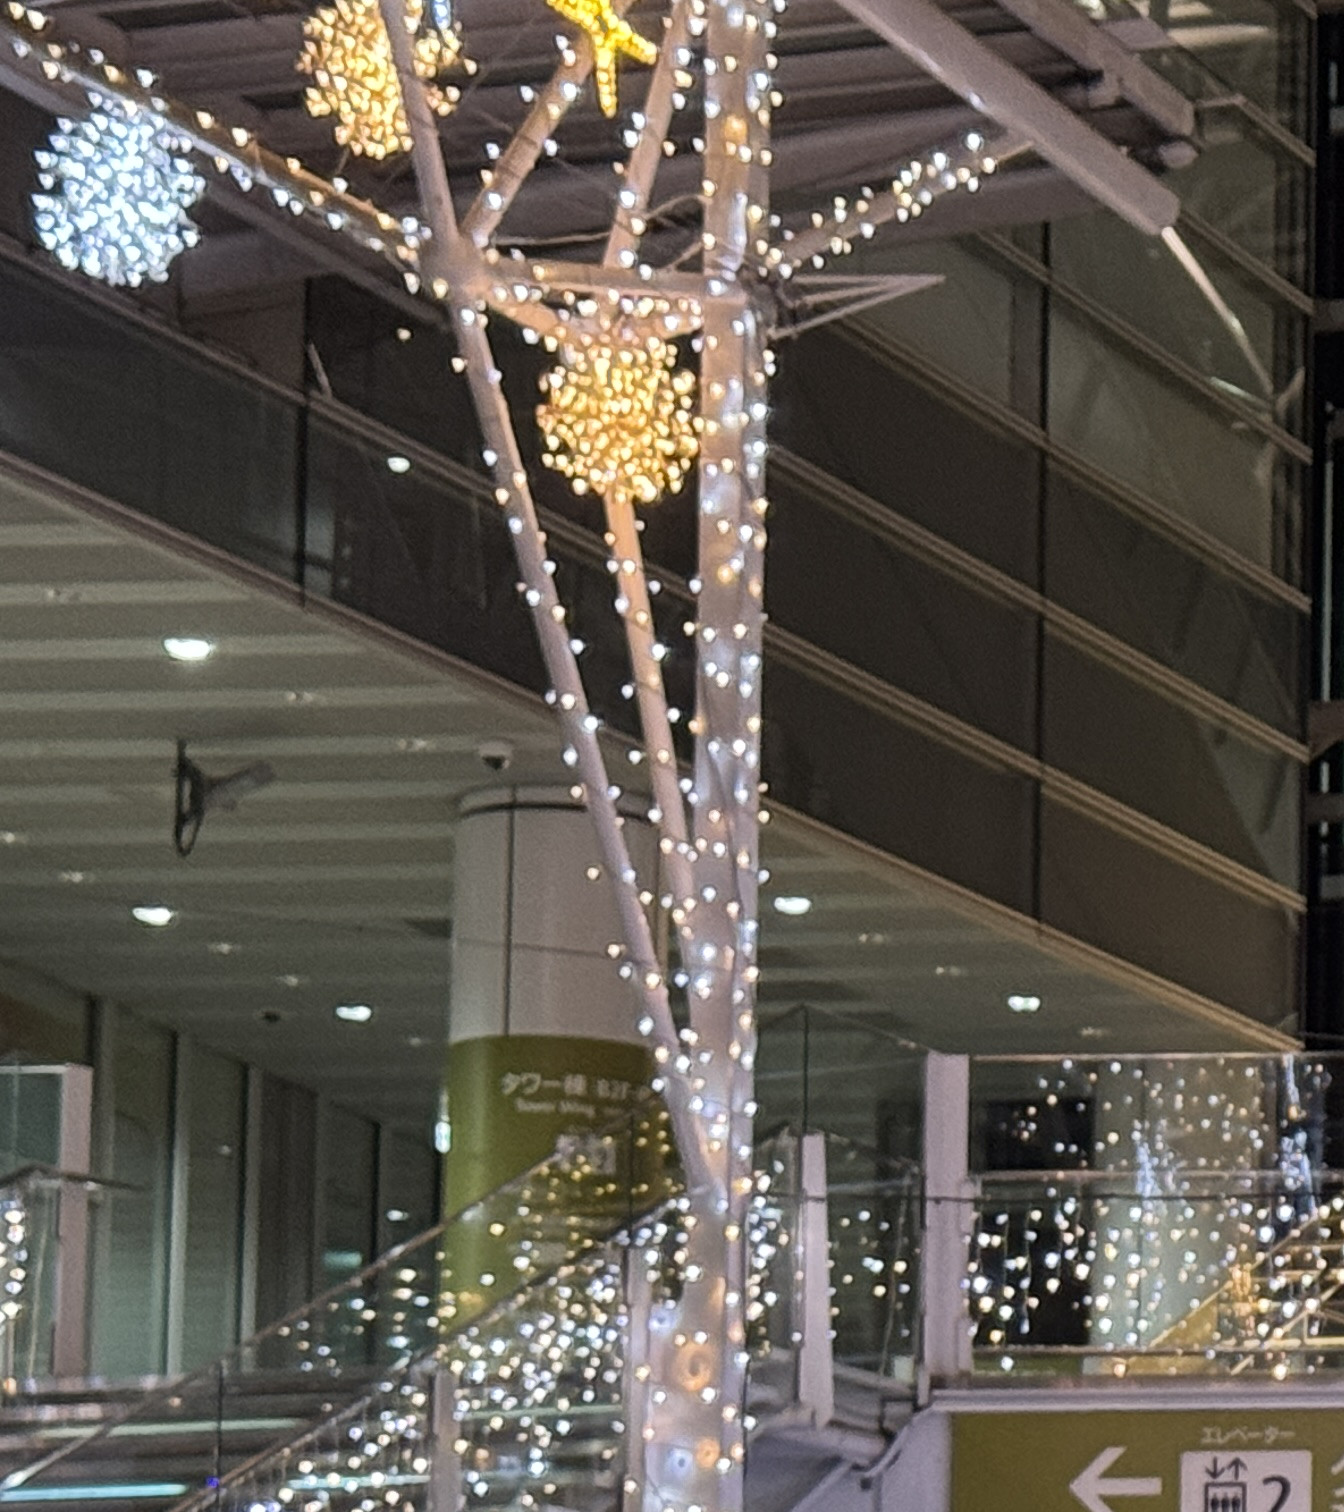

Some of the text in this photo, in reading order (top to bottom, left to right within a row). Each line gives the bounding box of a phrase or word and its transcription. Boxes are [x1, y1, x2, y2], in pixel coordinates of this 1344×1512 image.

[1201, 1426, 1296, 1444] エレベーター
